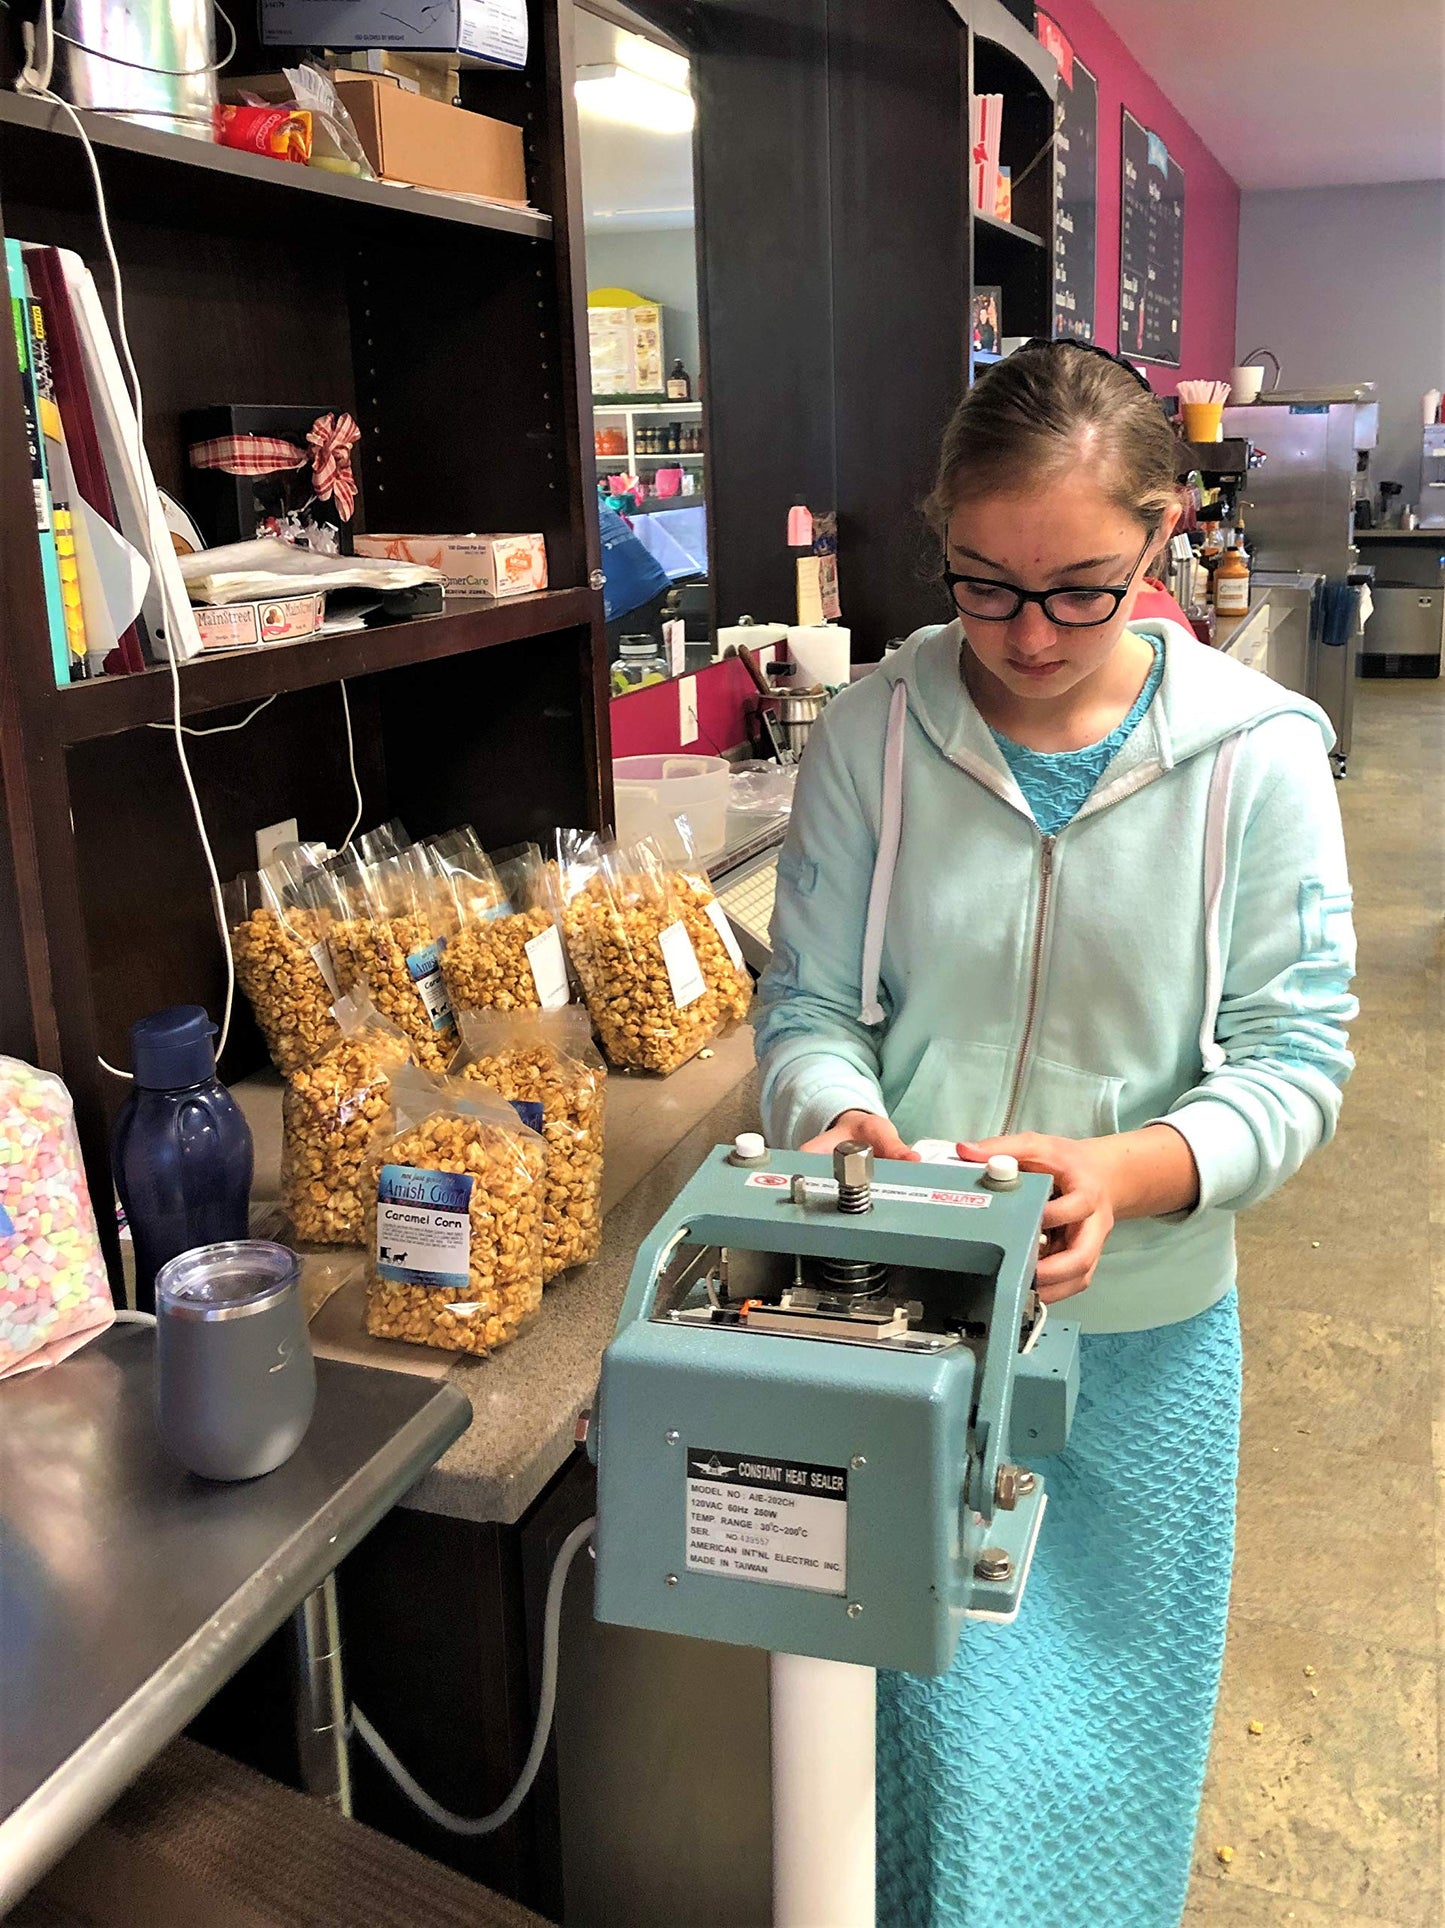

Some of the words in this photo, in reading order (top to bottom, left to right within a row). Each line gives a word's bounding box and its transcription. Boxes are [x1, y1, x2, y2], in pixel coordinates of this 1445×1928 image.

[386, 1179, 425, 1200] Amish
[931, 1192, 987, 1206] CAUTION
[385, 1210, 429, 1224] Caramel
[434, 1217, 462, 1228] Corn
[738, 1462, 782, 1482] CONSTANT
[785, 1469, 808, 1486] HEAT
[810, 1473, 845, 1491] SEALER
[691, 1484, 723, 1496] MODEL
[748, 1493, 796, 1507] AIE-202CH
[691, 1499, 723, 1510] 120VAC
[727, 1504, 749, 1514] 60Hz
[754, 1508, 778, 1519] 250W
[720, 1516, 753, 1529] RANGE
[690, 1540, 737, 1554] AMERICAN
[774, 1553, 819, 1568] ELECTRIC
[824, 1561, 842, 1572] INC.
[690, 1555, 715, 1565] MADE
[720, 1559, 729, 1567] IN
[734, 1560, 768, 1573] TAIWAN
